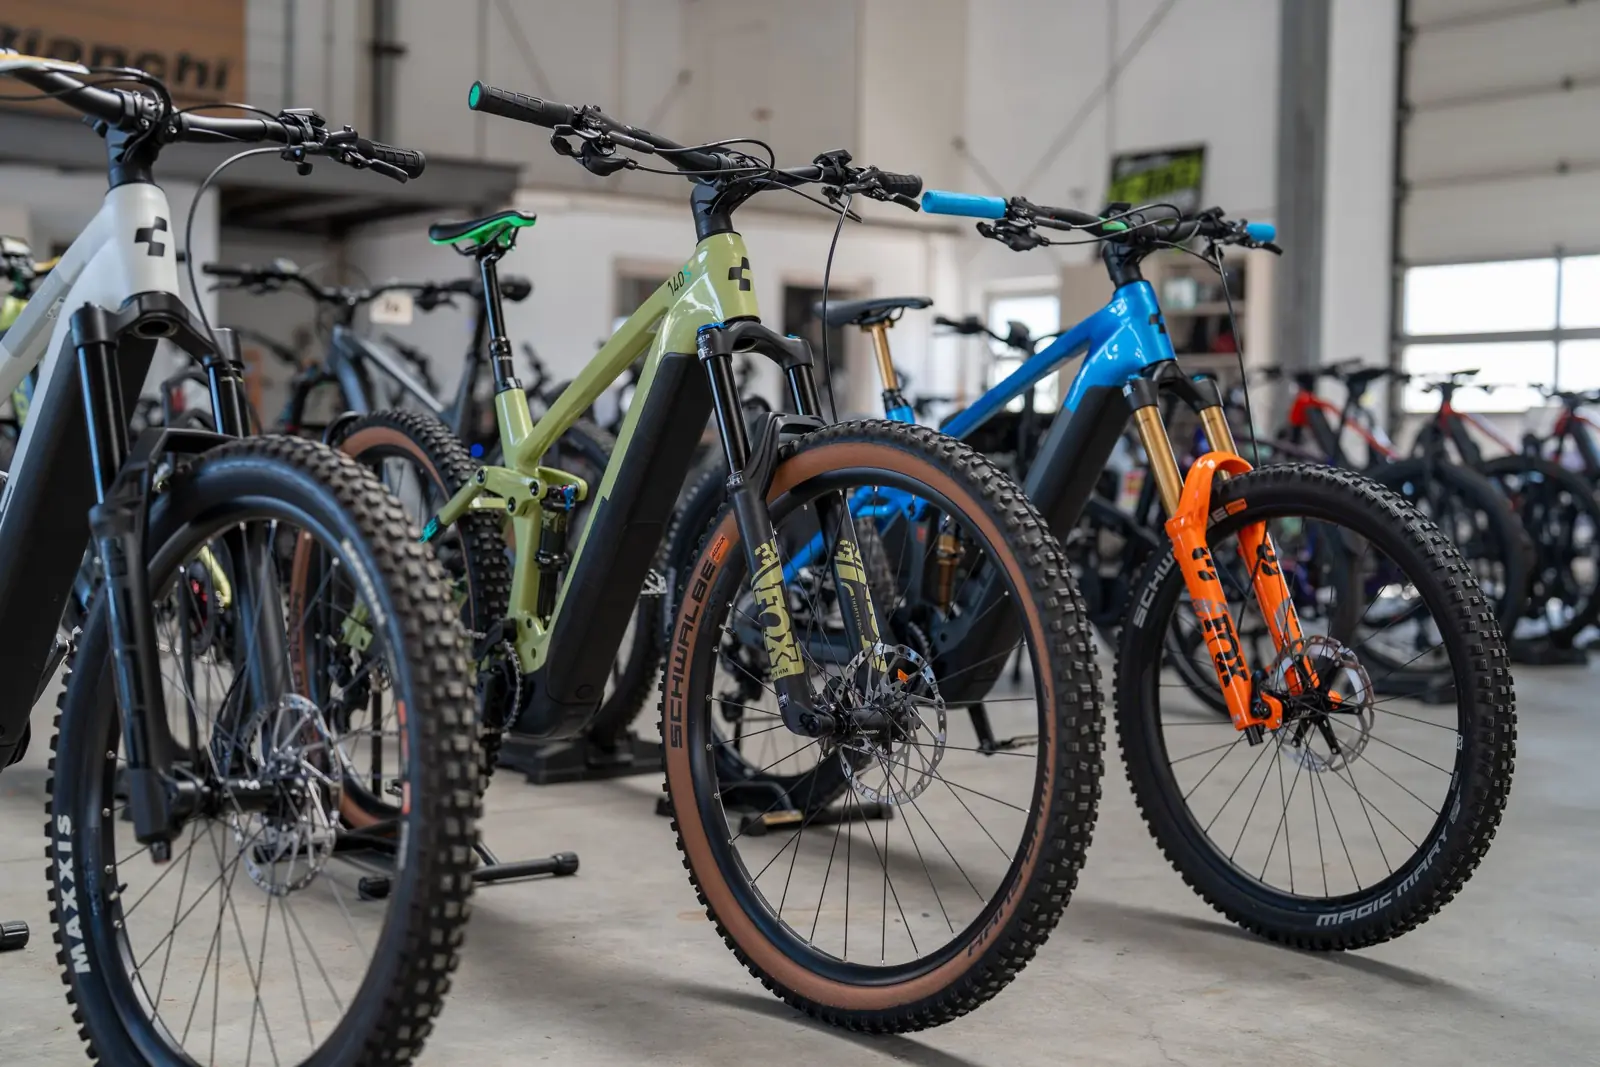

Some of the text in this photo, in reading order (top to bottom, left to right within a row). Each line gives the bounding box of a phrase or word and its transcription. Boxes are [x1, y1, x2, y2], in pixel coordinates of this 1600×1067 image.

[0, 25, 229, 90] ianchi
[670, 559, 716, 748] SCHWALBE
[755, 582, 799, 668] FOX
[1204, 614, 1248, 687] FOX
[57, 814, 91, 974] MAXXIS
[1316, 826, 1448, 926] MAGIC MARY
